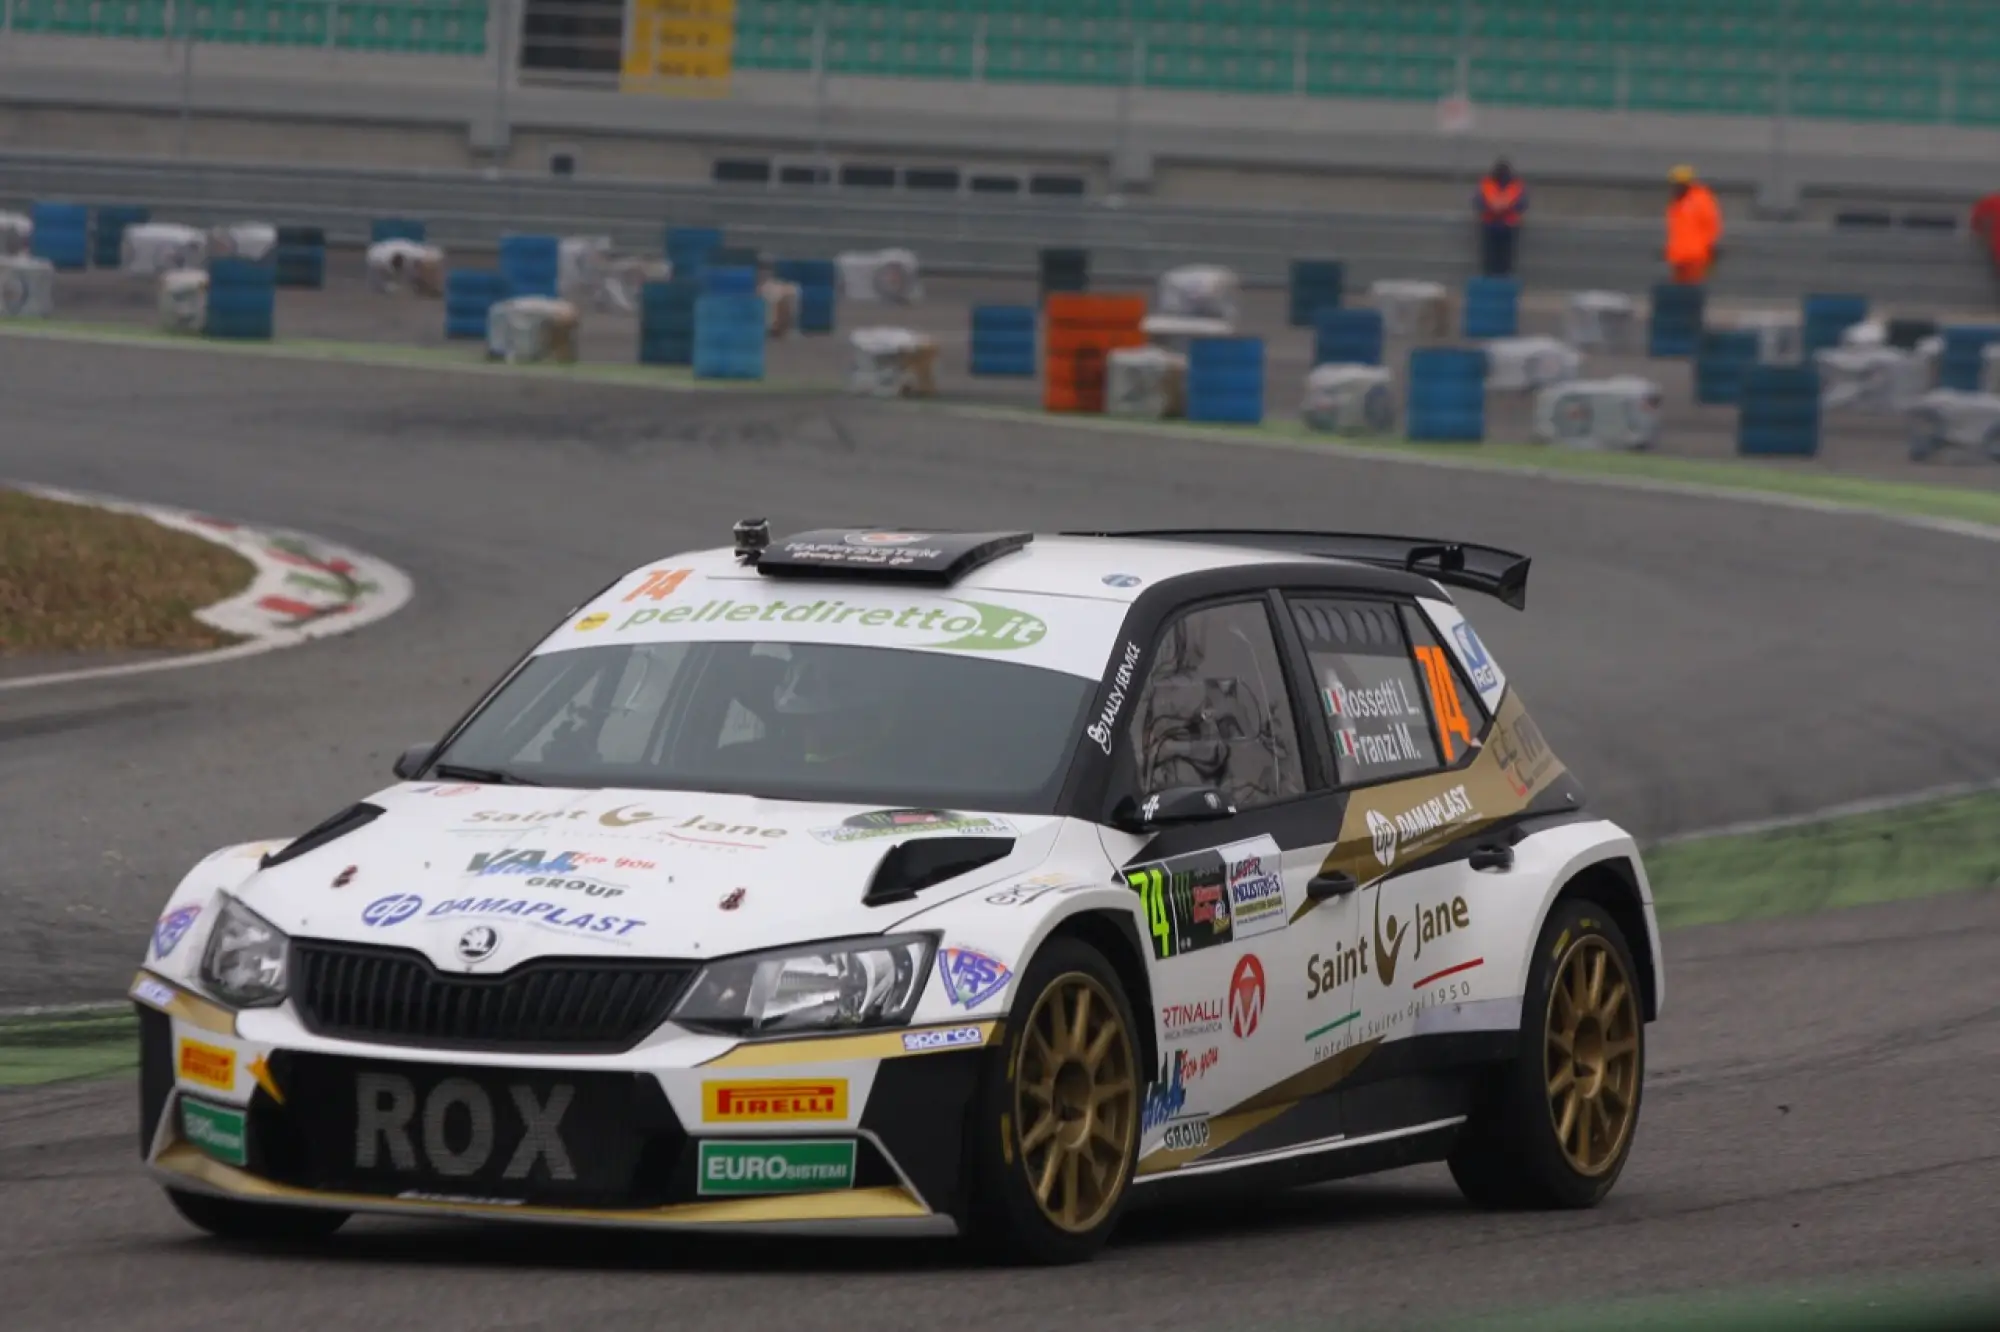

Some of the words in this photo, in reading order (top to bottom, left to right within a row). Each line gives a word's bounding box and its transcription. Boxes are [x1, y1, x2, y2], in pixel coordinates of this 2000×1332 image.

[620, 568, 695, 602] 74
[615, 599, 1046, 646] pelletdiretto.it
[462, 810, 588, 823] Saint
[673, 815, 787, 840] Jane
[1395, 784, 1473, 842] DAMAPLAST
[524, 876, 625, 899] GROUP
[426, 897, 647, 937] DAMAPLAST
[1307, 936, 1369, 1000] Saint
[1413, 895, 1471, 960] Jane
[717, 1086, 835, 1115] PIRELLI
[355, 1072, 577, 1181] ROX
[1163, 1120, 1210, 1149] GROUP
